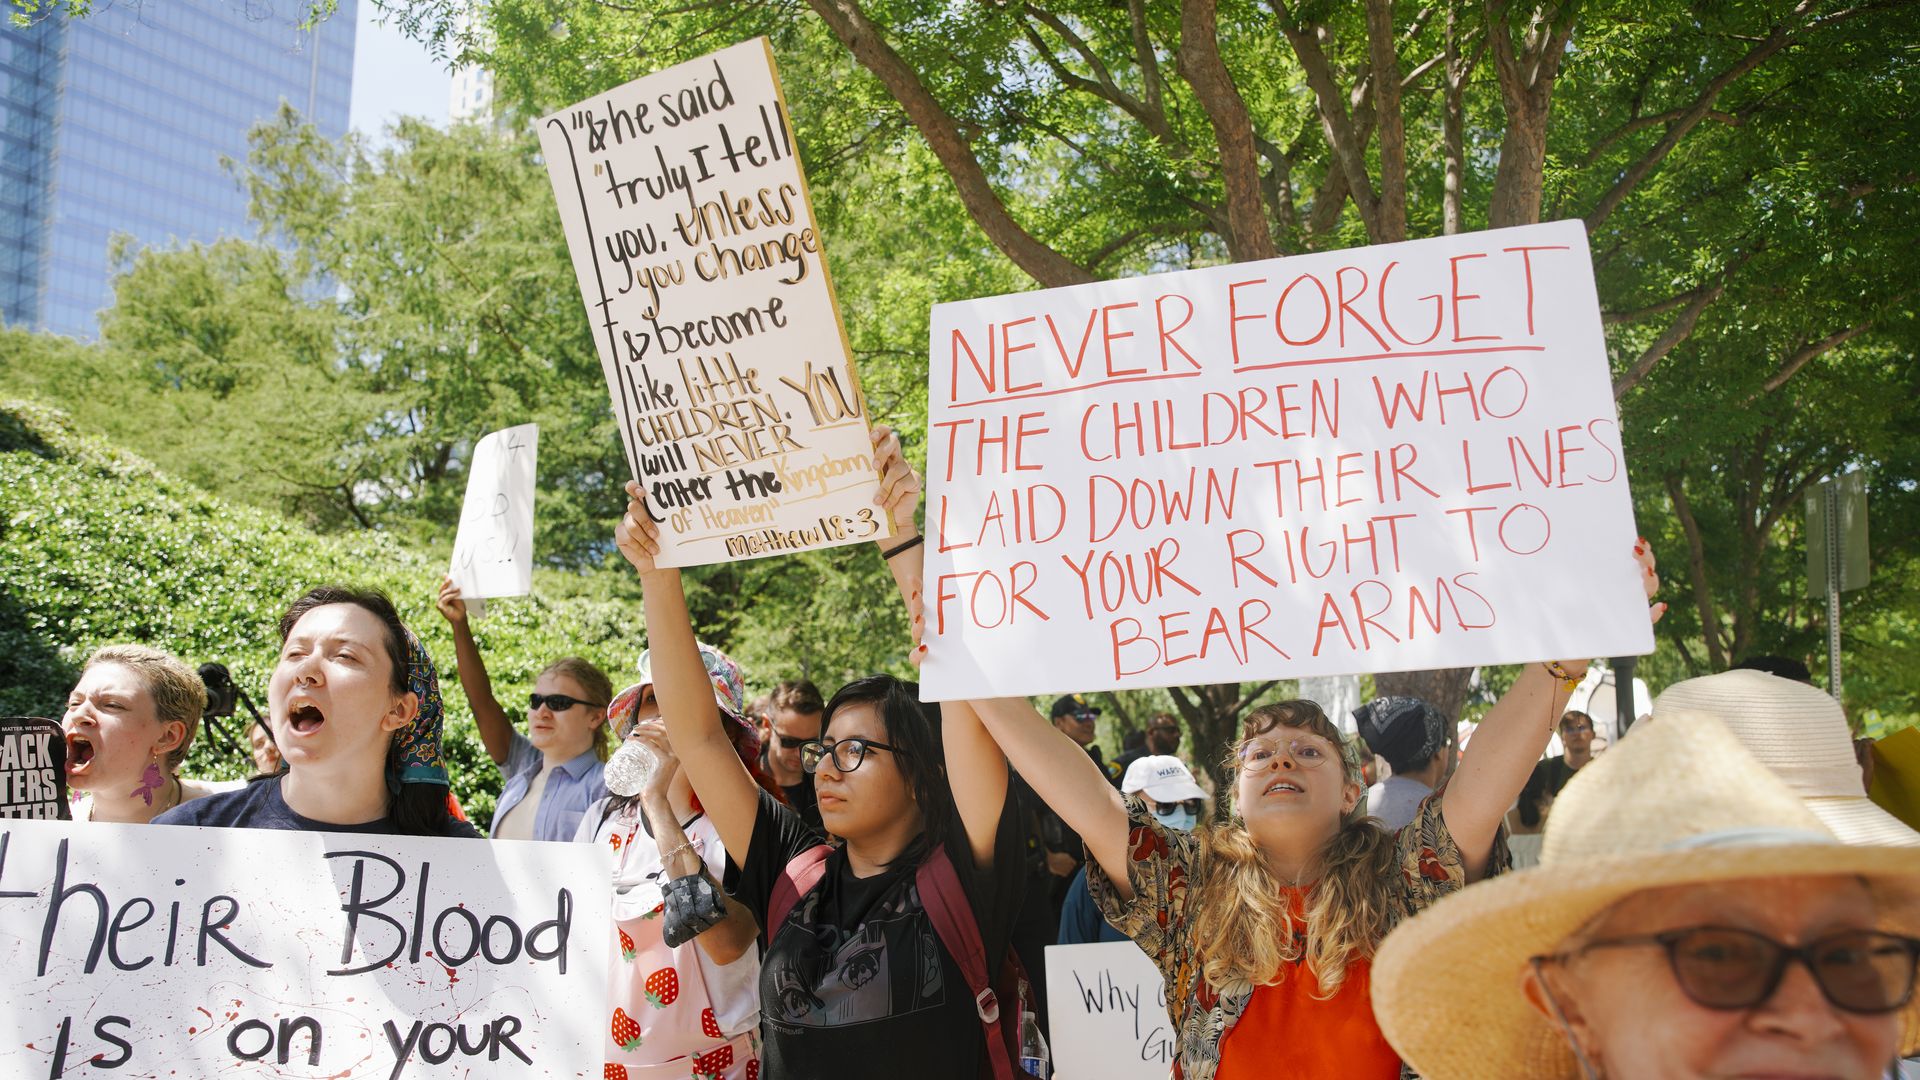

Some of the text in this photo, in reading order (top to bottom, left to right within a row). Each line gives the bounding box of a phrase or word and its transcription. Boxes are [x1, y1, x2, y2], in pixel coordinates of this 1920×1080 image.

[658, 59, 734, 126] said
[689, 145, 715, 182] I
[719, 101, 792, 173] tell
[636, 228, 817, 320] you change
[949, 245, 1571, 402] NEVER FORGET
[626, 352, 762, 414] like little
[779, 361, 862, 426] YOU
[641, 423, 808, 476] will NEVER
[933, 365, 1529, 482] THE CHILDREN WHO
[651, 453, 872, 509] enter the Kingdom
[938, 418, 1617, 554] LAID DOWN THEIR LIVES
[671, 509, 693, 534] of
[819, 508, 880, 543] 18:3
[937, 503, 1551, 635] FOR YOUR RIGHT TO
[1111, 572, 1497, 680] BEAR ARMS
[323, 850, 573, 976] Blood
[1073, 969, 1139, 1040] Why
[227, 1017, 321, 1066] on
